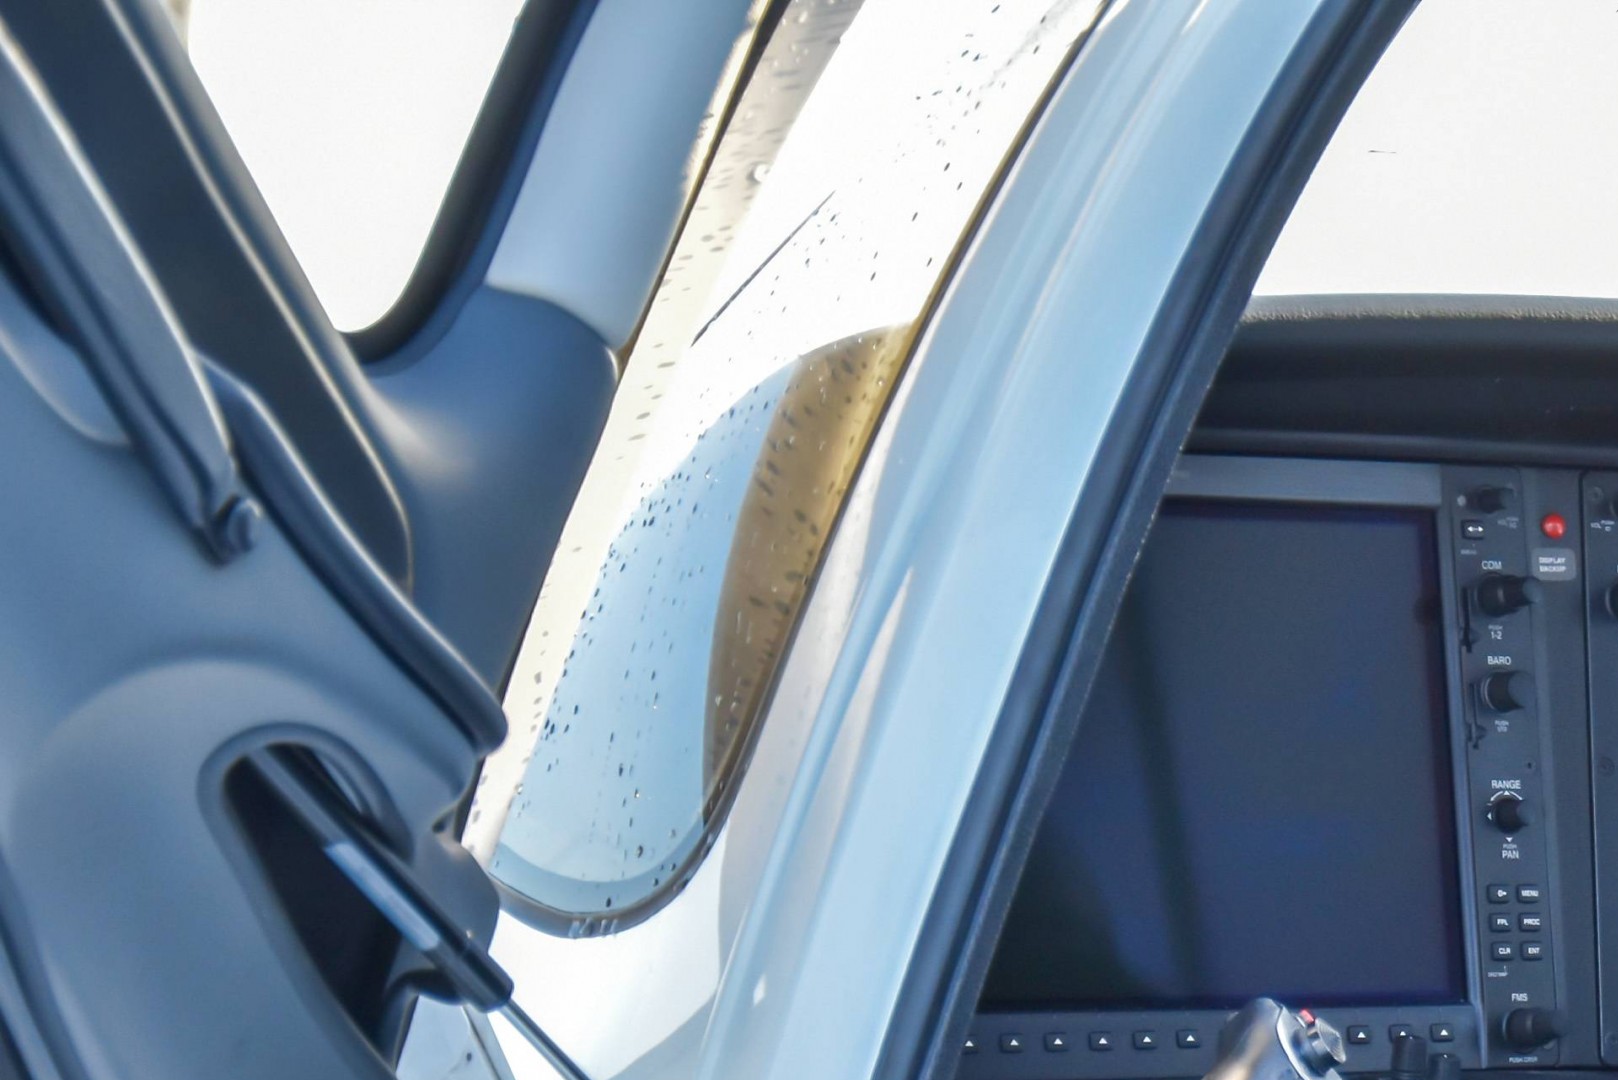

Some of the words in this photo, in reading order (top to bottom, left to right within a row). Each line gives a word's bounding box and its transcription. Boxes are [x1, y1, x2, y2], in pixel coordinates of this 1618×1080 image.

[1481, 560, 1502, 570] COM
[1490, 631, 1503, 640] 1-2
[1487, 656, 1511, 666] BARO
[1491, 779, 1521, 790] RANGE
[1502, 850, 1519, 859] PAN
[1497, 918, 1509, 926] FPL
[1498, 947, 1511, 955] CLR
[1511, 993, 1528, 1002] FMS
